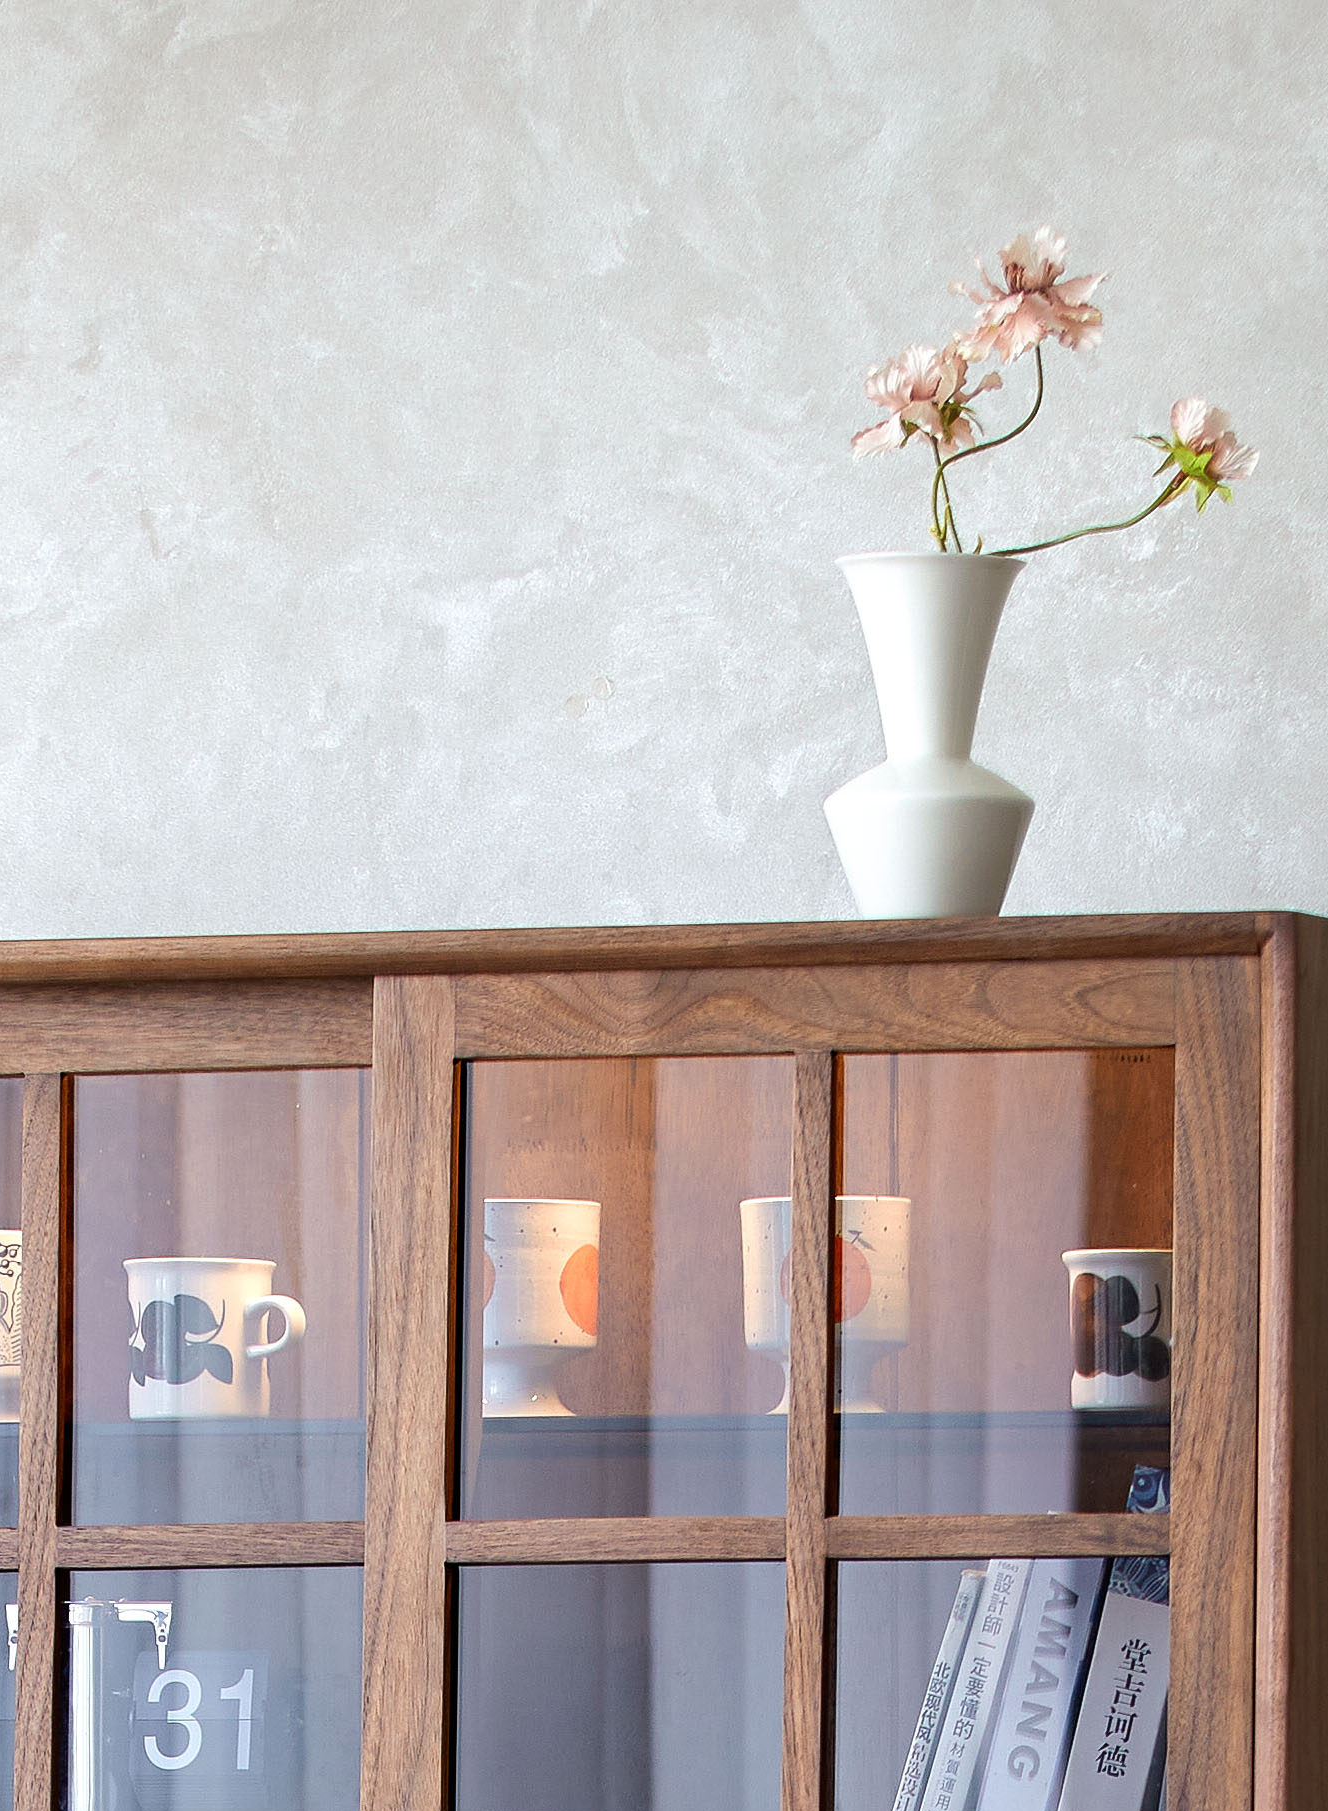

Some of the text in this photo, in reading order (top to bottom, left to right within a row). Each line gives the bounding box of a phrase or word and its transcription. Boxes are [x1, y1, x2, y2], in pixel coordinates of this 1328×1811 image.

[143, 1668, 254, 1771] 31
[1095, 1638, 1152, 1778] 堂吉诃德
